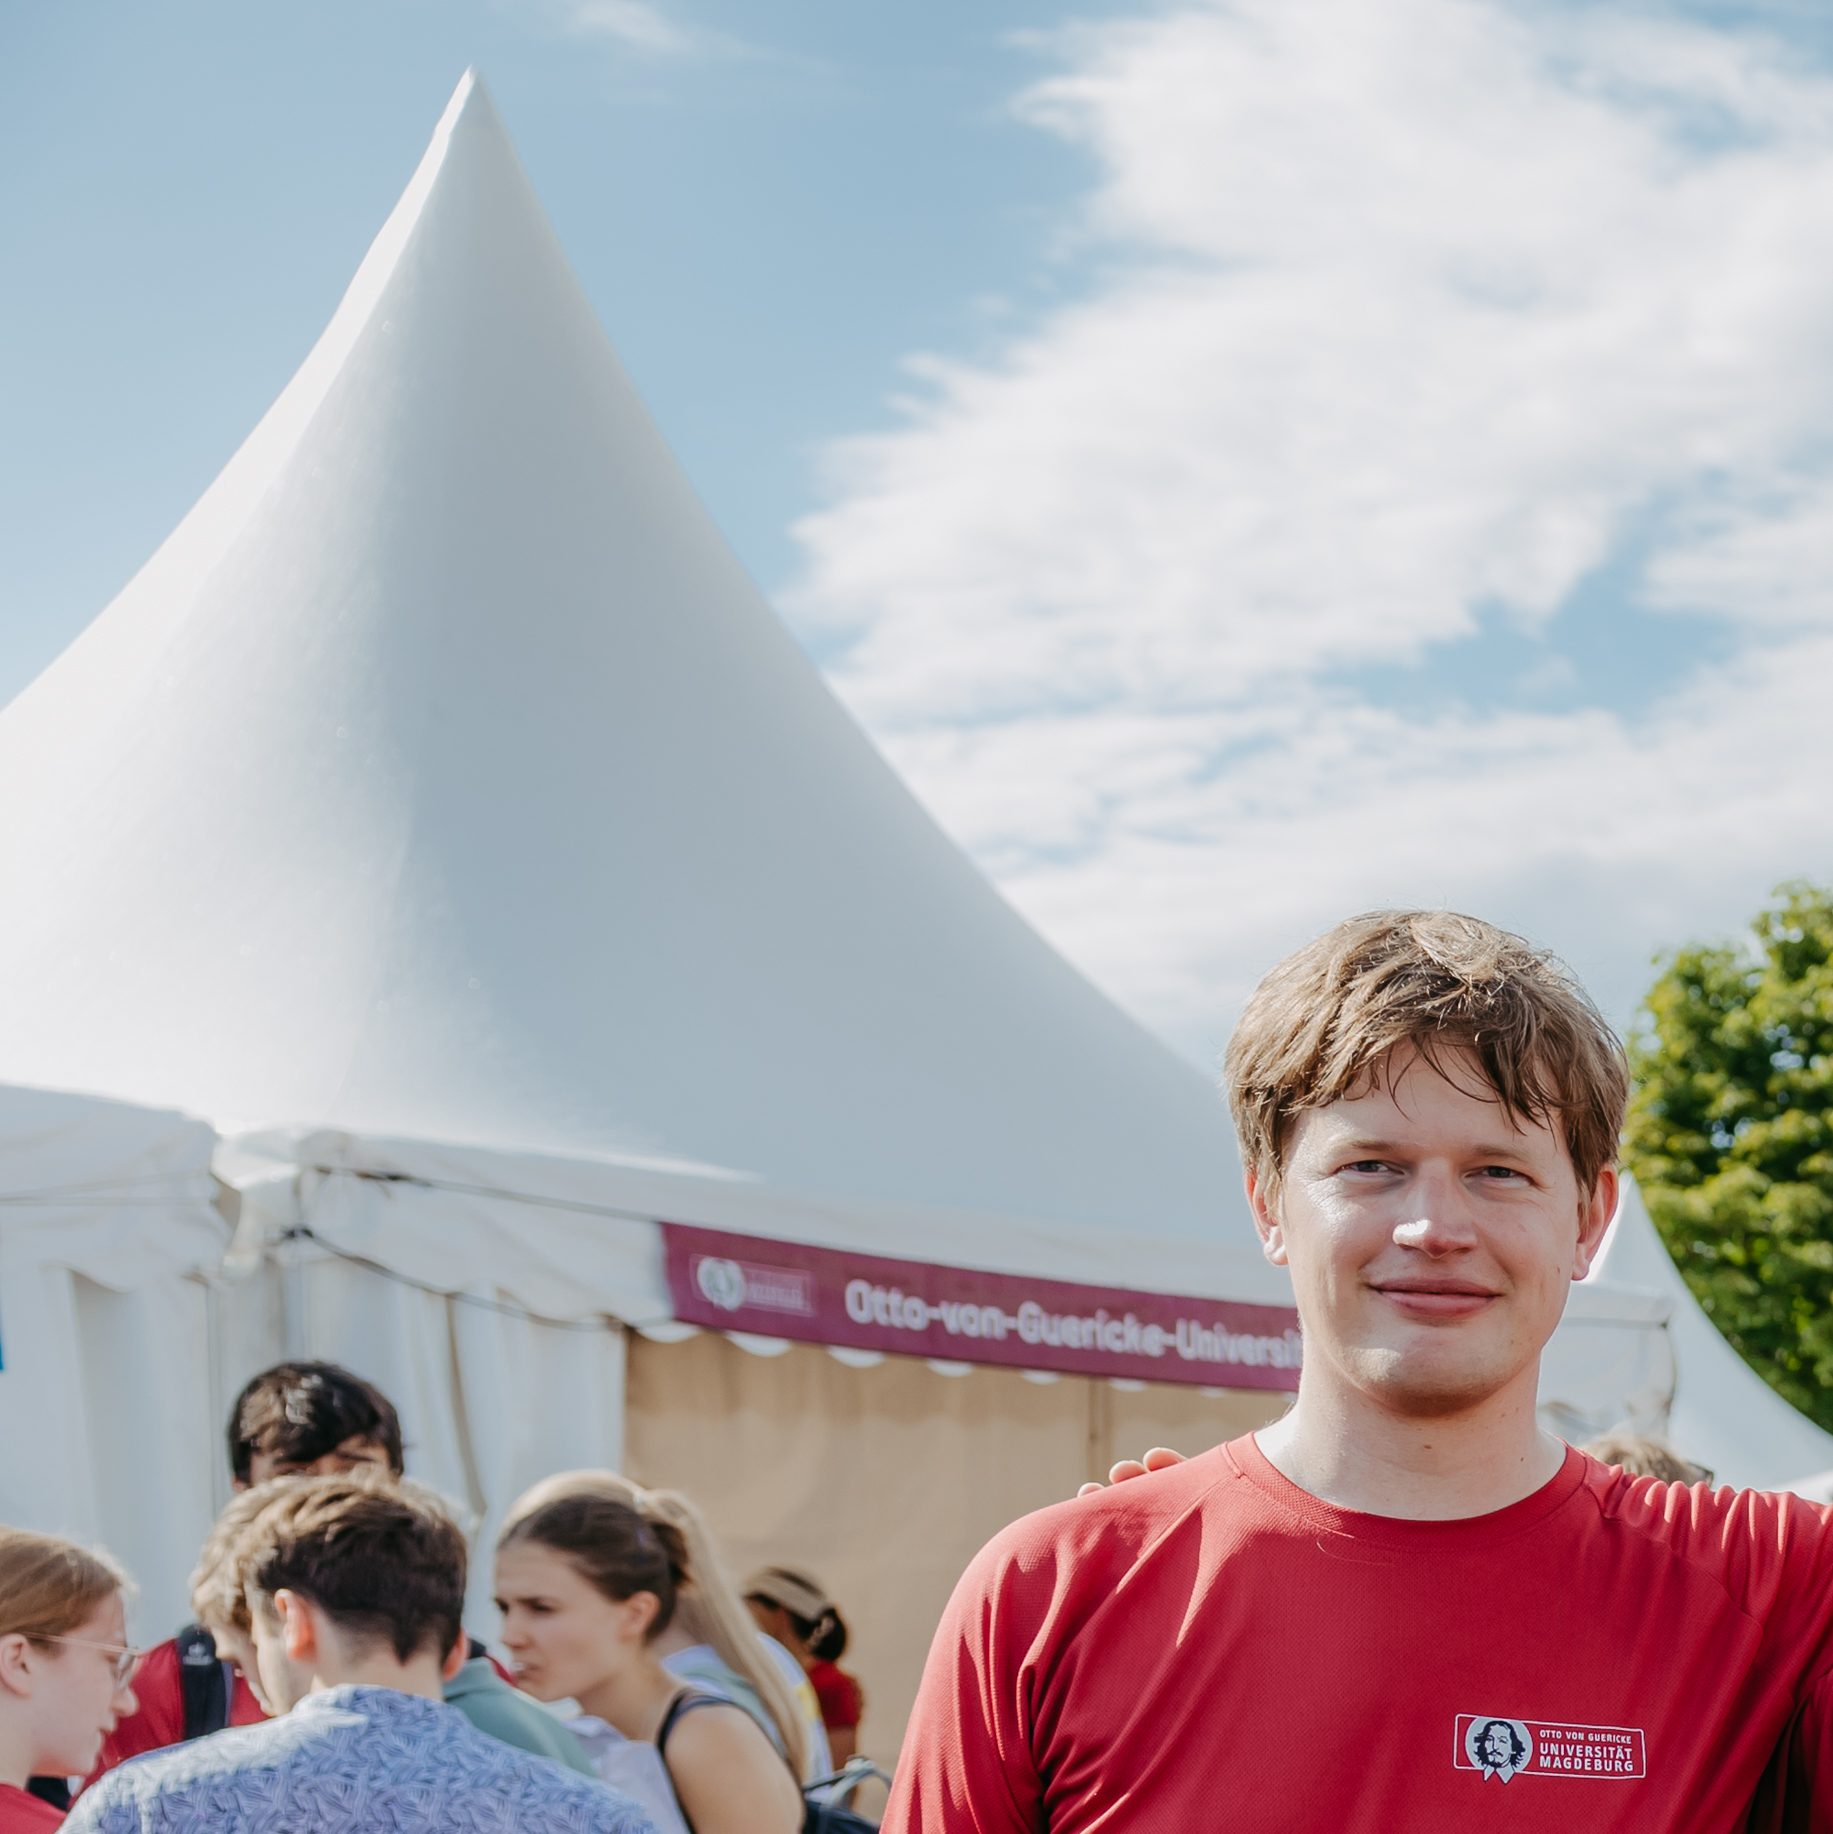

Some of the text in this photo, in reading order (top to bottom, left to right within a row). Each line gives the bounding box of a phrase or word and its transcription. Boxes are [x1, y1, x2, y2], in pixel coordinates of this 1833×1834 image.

[1539, 1729, 1632, 1744] OTTO VON GUERICKE
[1539, 1743, 1633, 1760] UNIVERSITÄT
[1539, 1756, 1634, 1772] MAGDEBURG
